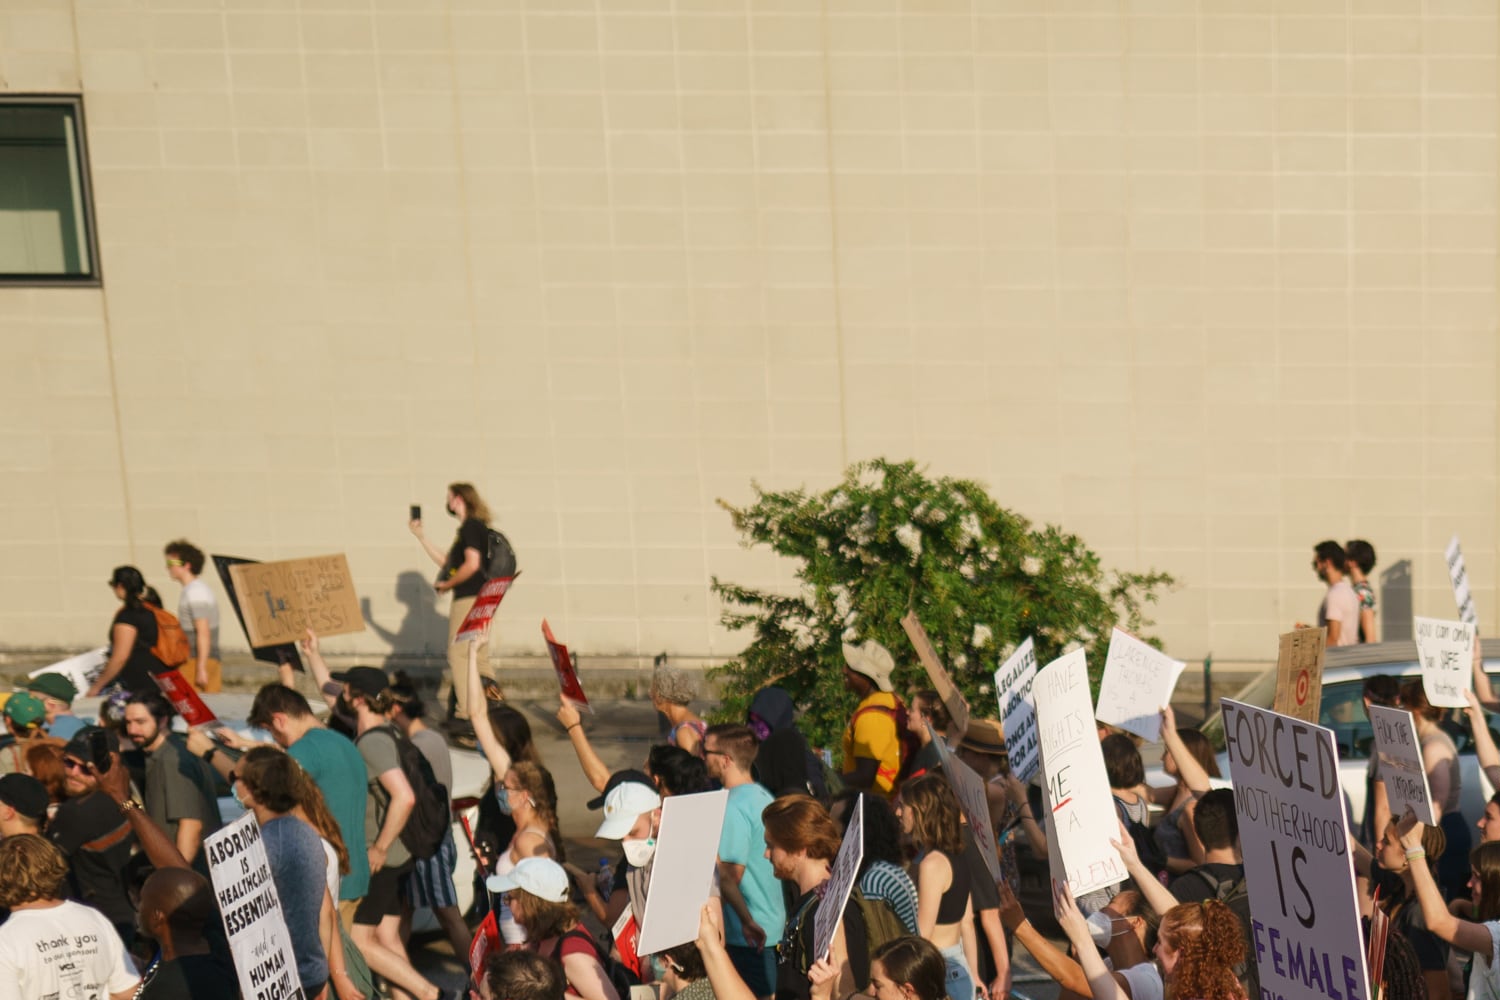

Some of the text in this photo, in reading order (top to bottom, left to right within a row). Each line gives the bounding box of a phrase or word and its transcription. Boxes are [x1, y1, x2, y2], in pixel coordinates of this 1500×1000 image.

[1416, 623, 1470, 651] you can only
[996, 650, 1035, 699] LEGALIZE
[1047, 662, 1080, 697] HAVE
[1006, 722, 1026, 753] ONCE
[1042, 708, 1085, 753] RIGHTS
[1221, 703, 1337, 800] FORCED
[1235, 783, 1346, 856] MOTHERHOOD
[208, 821, 260, 869] ABORTION
[240, 856, 250, 876] IS
[1271, 840, 1316, 929] IS
[224, 887, 280, 937] ESSENTIAL,
[35, 933, 98, 953] thank you
[43, 956, 53, 965] to
[248, 947, 286, 989] HUMAN
